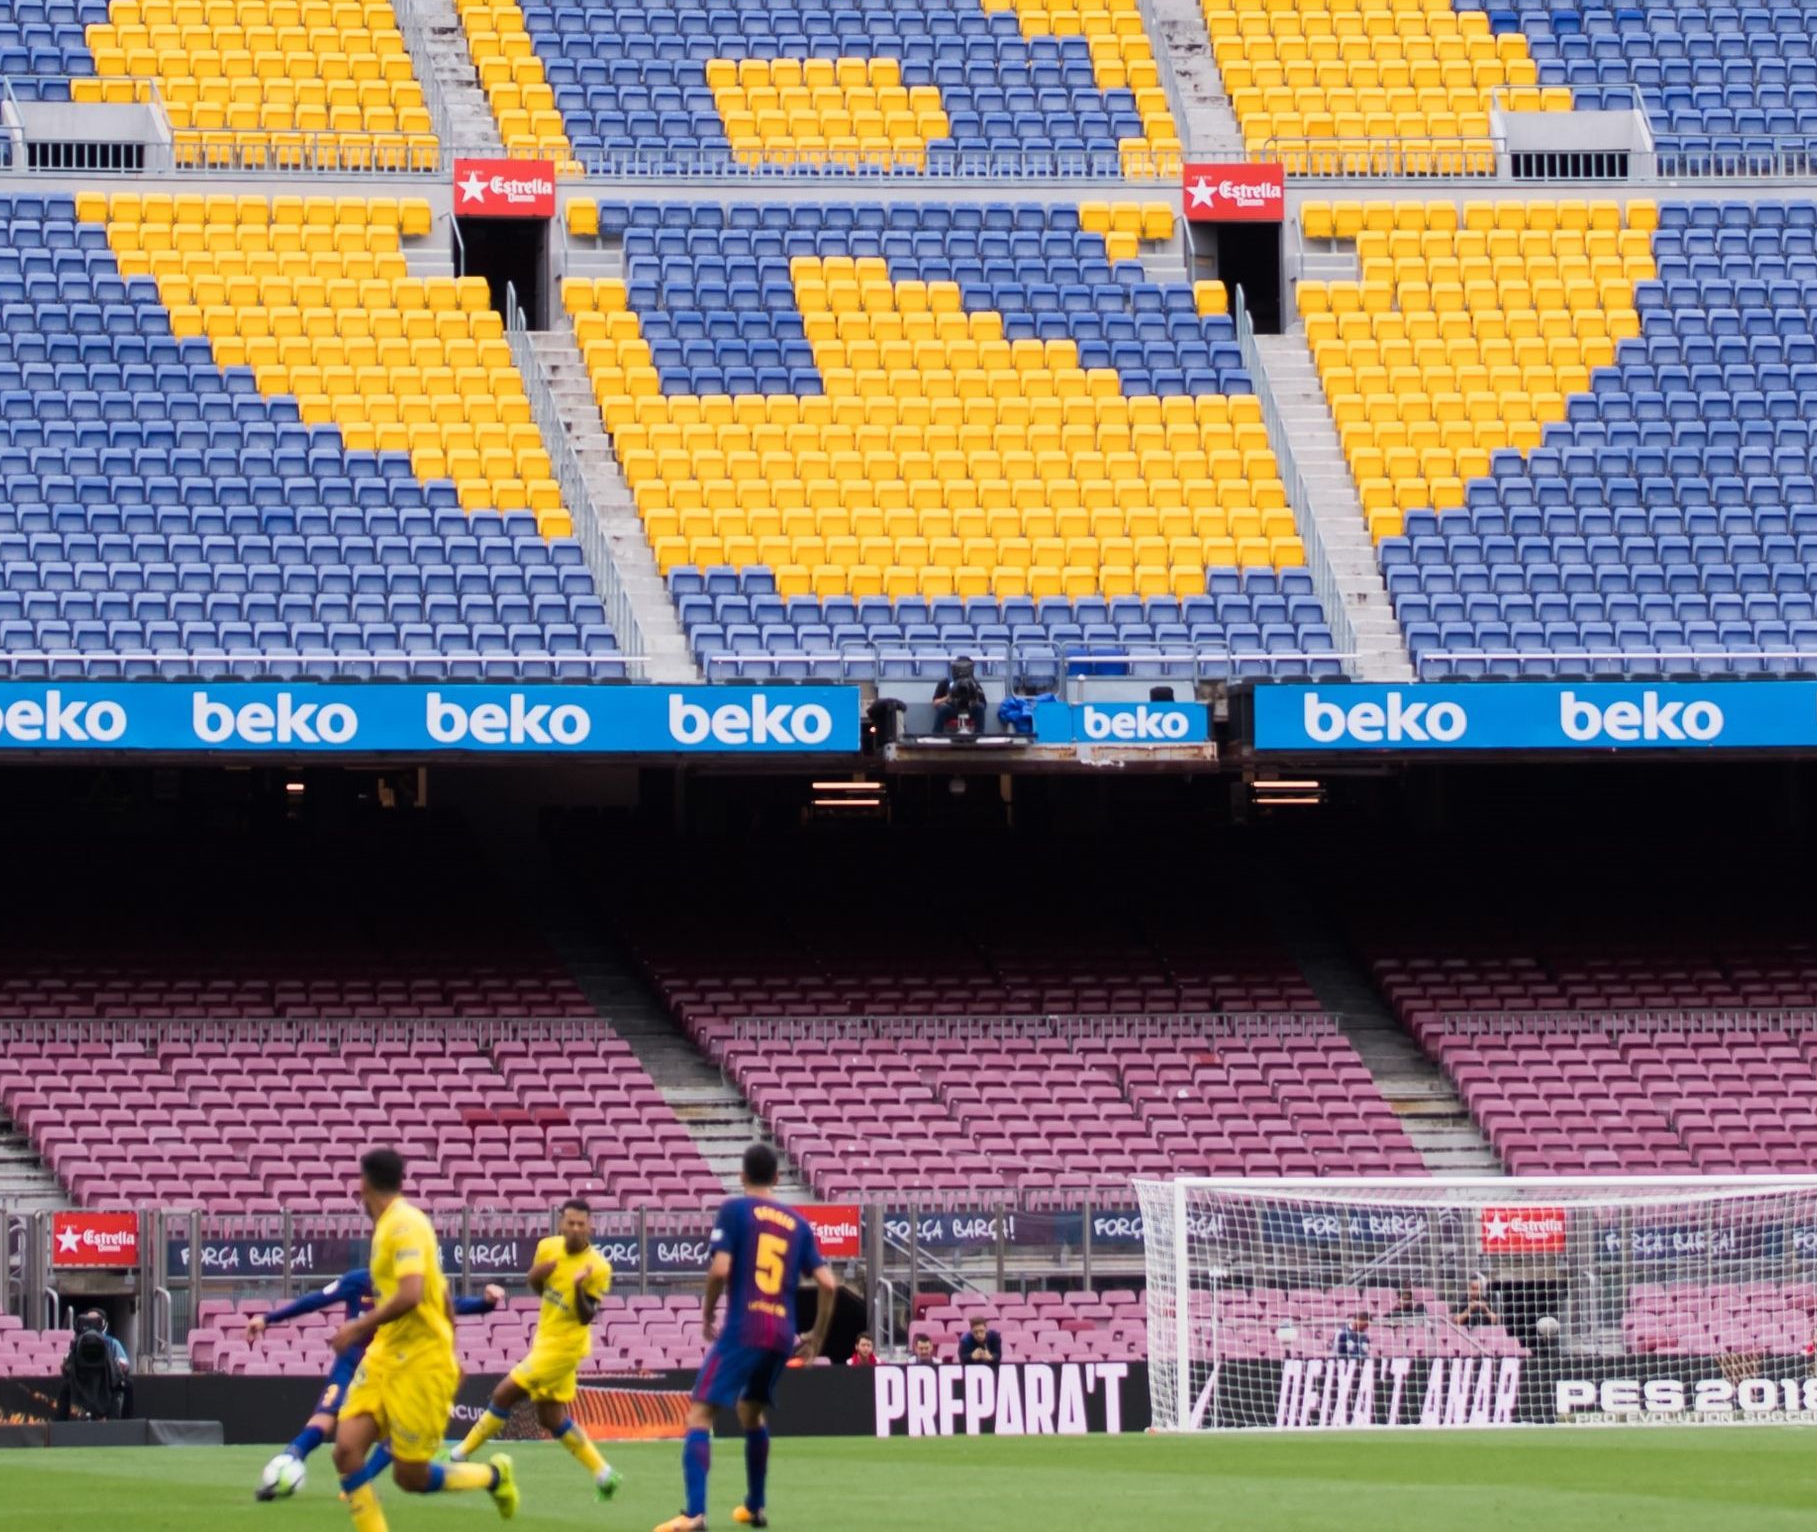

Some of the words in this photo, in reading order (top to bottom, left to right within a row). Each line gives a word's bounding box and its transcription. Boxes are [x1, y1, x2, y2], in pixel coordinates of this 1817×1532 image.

[490, 176, 552, 195] Estrella
[1218, 180, 1281, 199] Estrella
[193, 692, 357, 743] beko
[427, 693, 590, 744] beko
[669, 694, 831, 744] beko
[1084, 705, 1188, 739] beko
[1305, 692, 1466, 742] beko
[1561, 692, 1723, 740] beko
[83, 1229, 135, 1245] Estrella
[181, 1246, 240, 1269] FRÇA
[755, 1233, 788, 1295] 5
[874, 1363, 1128, 1437] PREPARA'T
[1420, 1357, 1520, 1425] ANAR
[1556, 1379, 1684, 1414] PES
